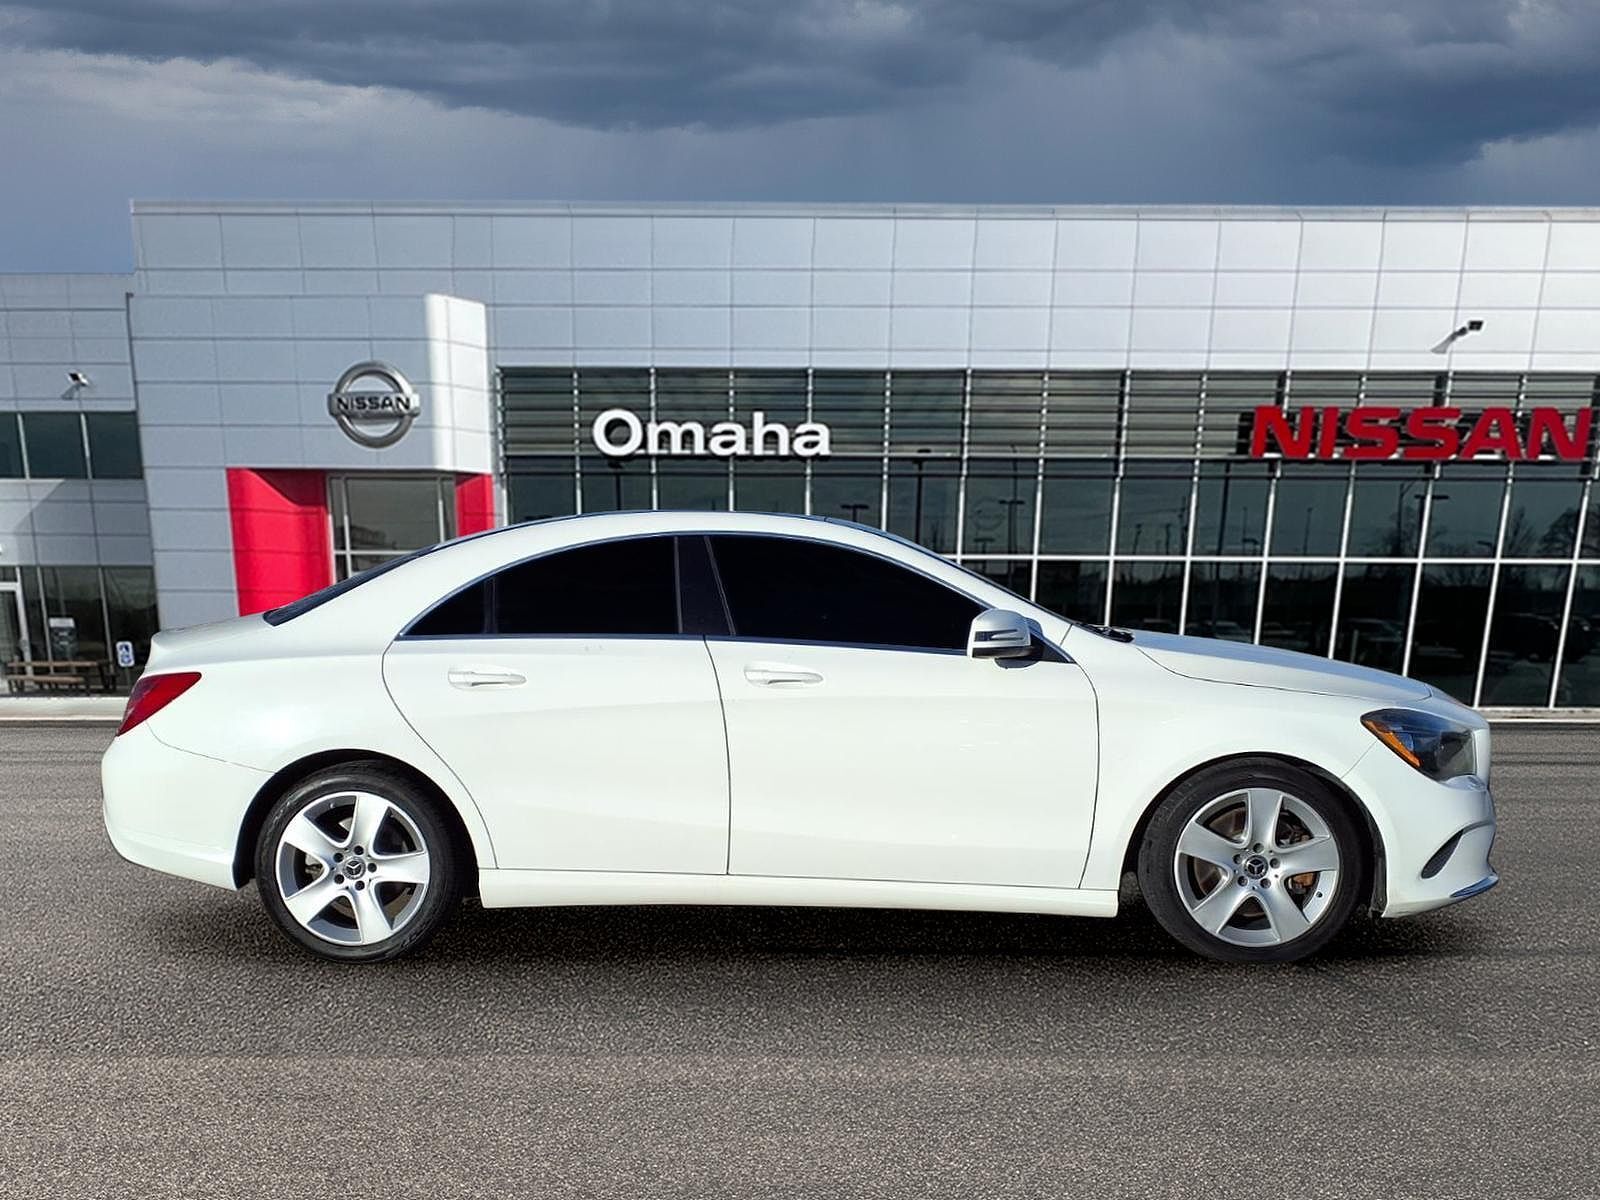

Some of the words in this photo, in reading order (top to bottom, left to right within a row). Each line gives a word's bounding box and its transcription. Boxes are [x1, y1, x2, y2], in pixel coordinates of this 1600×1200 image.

[336, 396, 411, 410] NISSAN
[593, 409, 832, 456] Omaha
[1250, 406, 1592, 461] NISSAN
